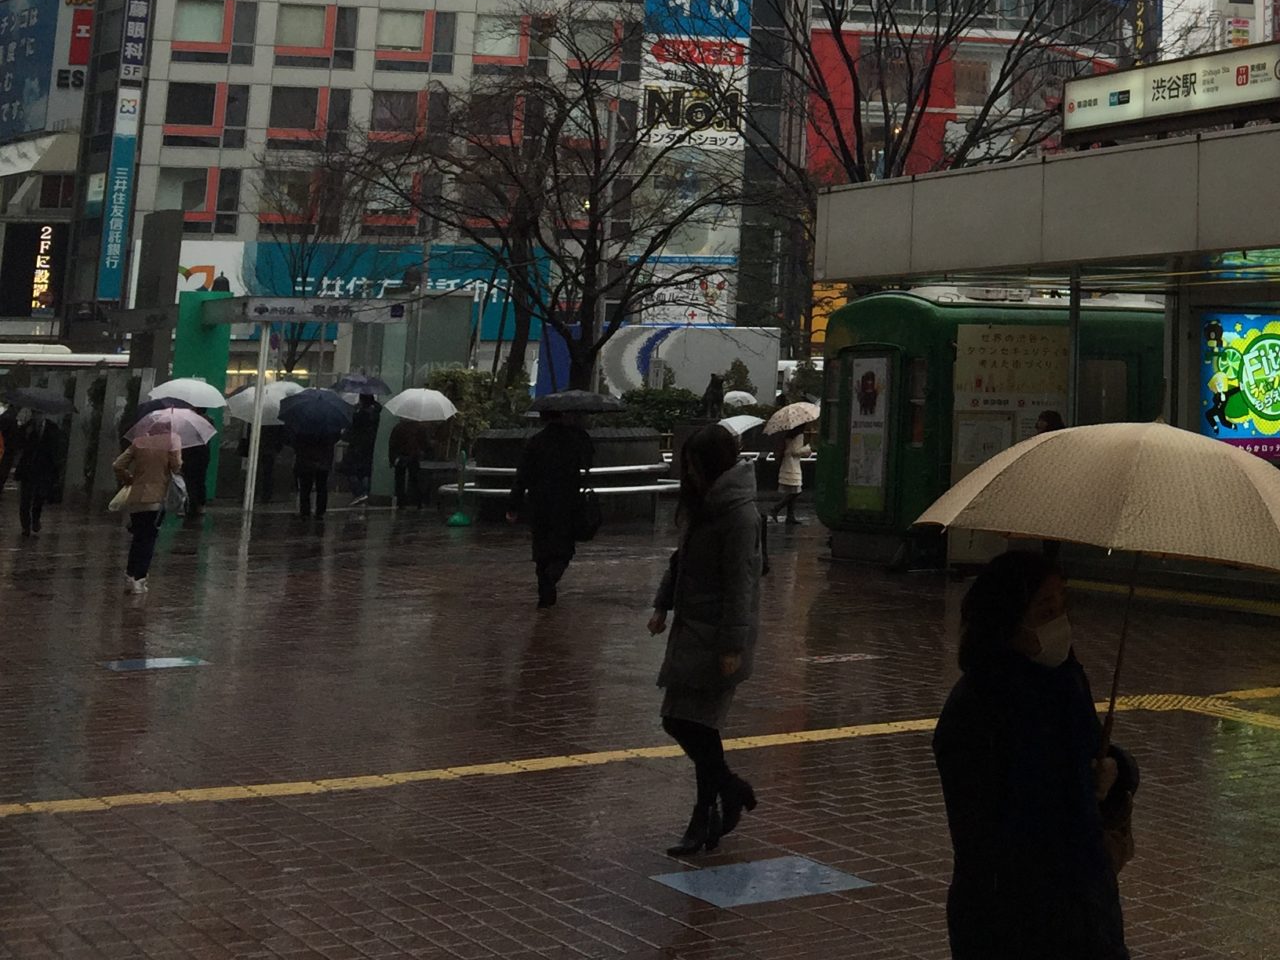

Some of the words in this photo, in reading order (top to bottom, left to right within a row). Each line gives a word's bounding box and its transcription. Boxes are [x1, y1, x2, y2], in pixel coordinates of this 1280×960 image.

[123, 65, 141, 77] 5F
[1237, 74, 1247, 83] 01
[1151, 73, 1197, 102] 渋谷駅
[104, 166, 129, 270] 三井住友信託銀行
